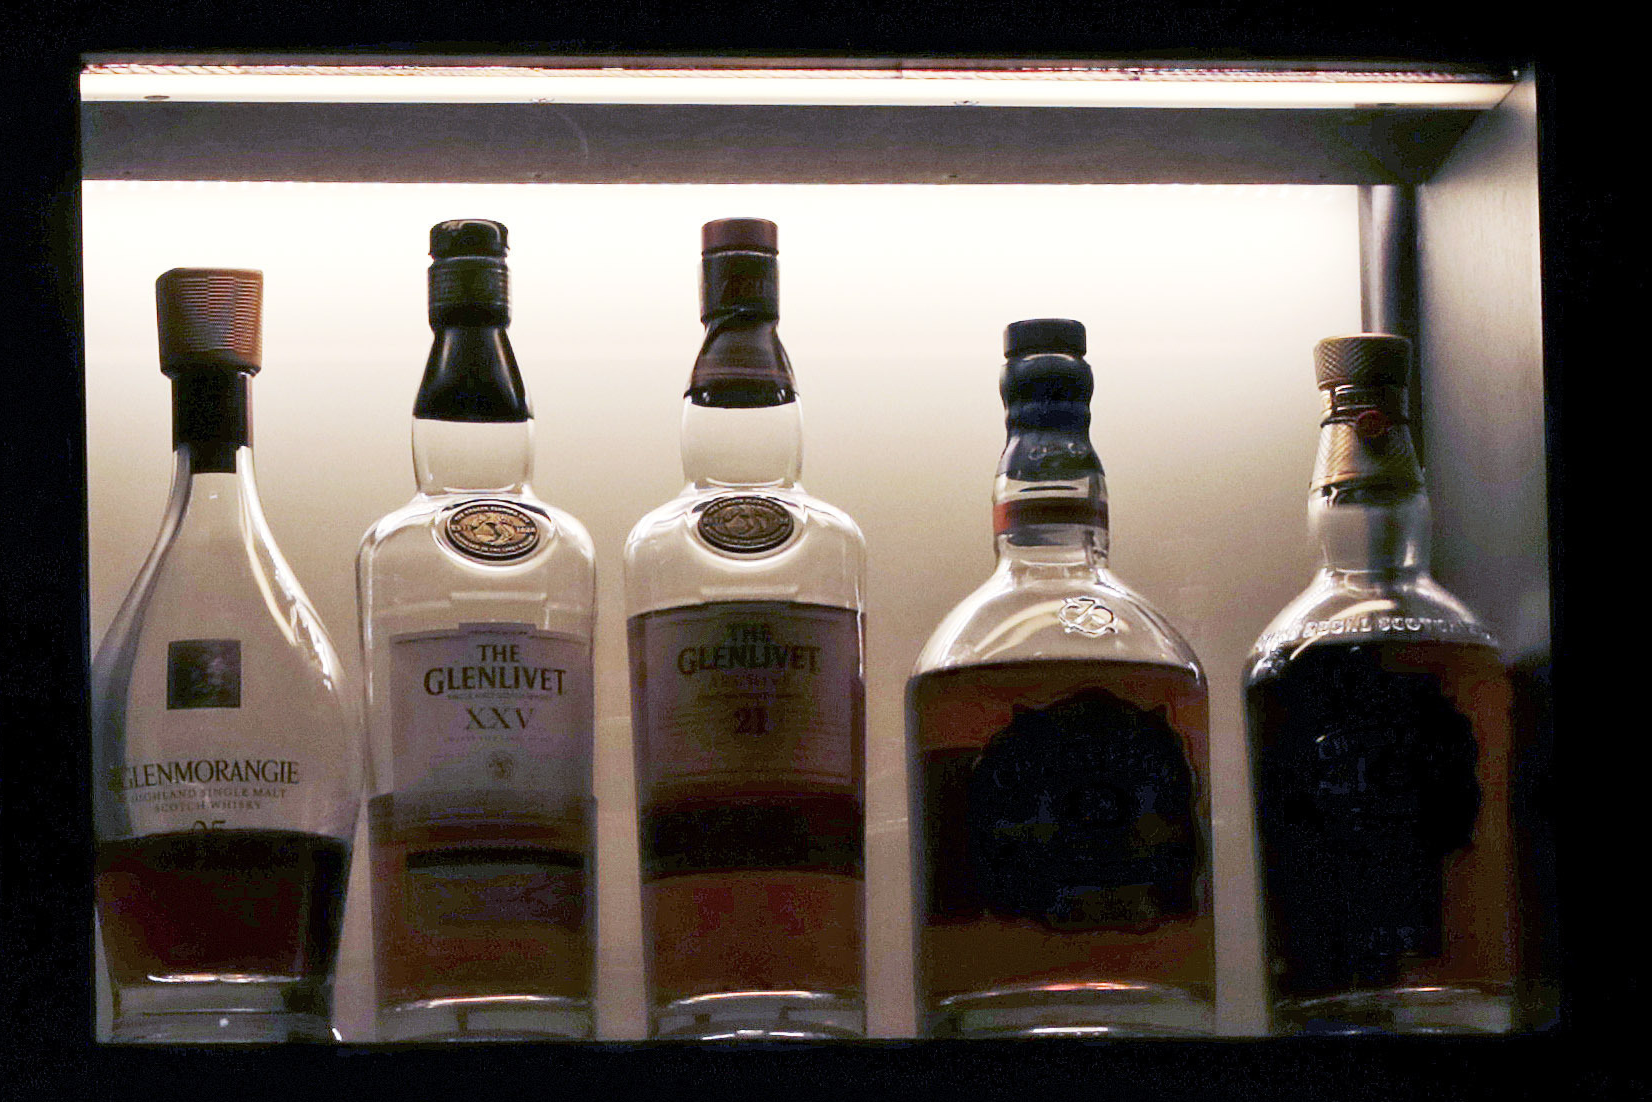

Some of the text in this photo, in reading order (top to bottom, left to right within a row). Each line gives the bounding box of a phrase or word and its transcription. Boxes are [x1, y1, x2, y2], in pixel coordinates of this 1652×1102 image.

[476, 644, 521, 663] THE
[677, 644, 822, 677] GLENLIVET
[423, 665, 567, 697] GLENLIVET
[465, 707, 535, 730] XXV
[733, 706, 769, 736] 21
[252, 785, 288, 800] MALT
[152, 801, 206, 814] SCOTCH
